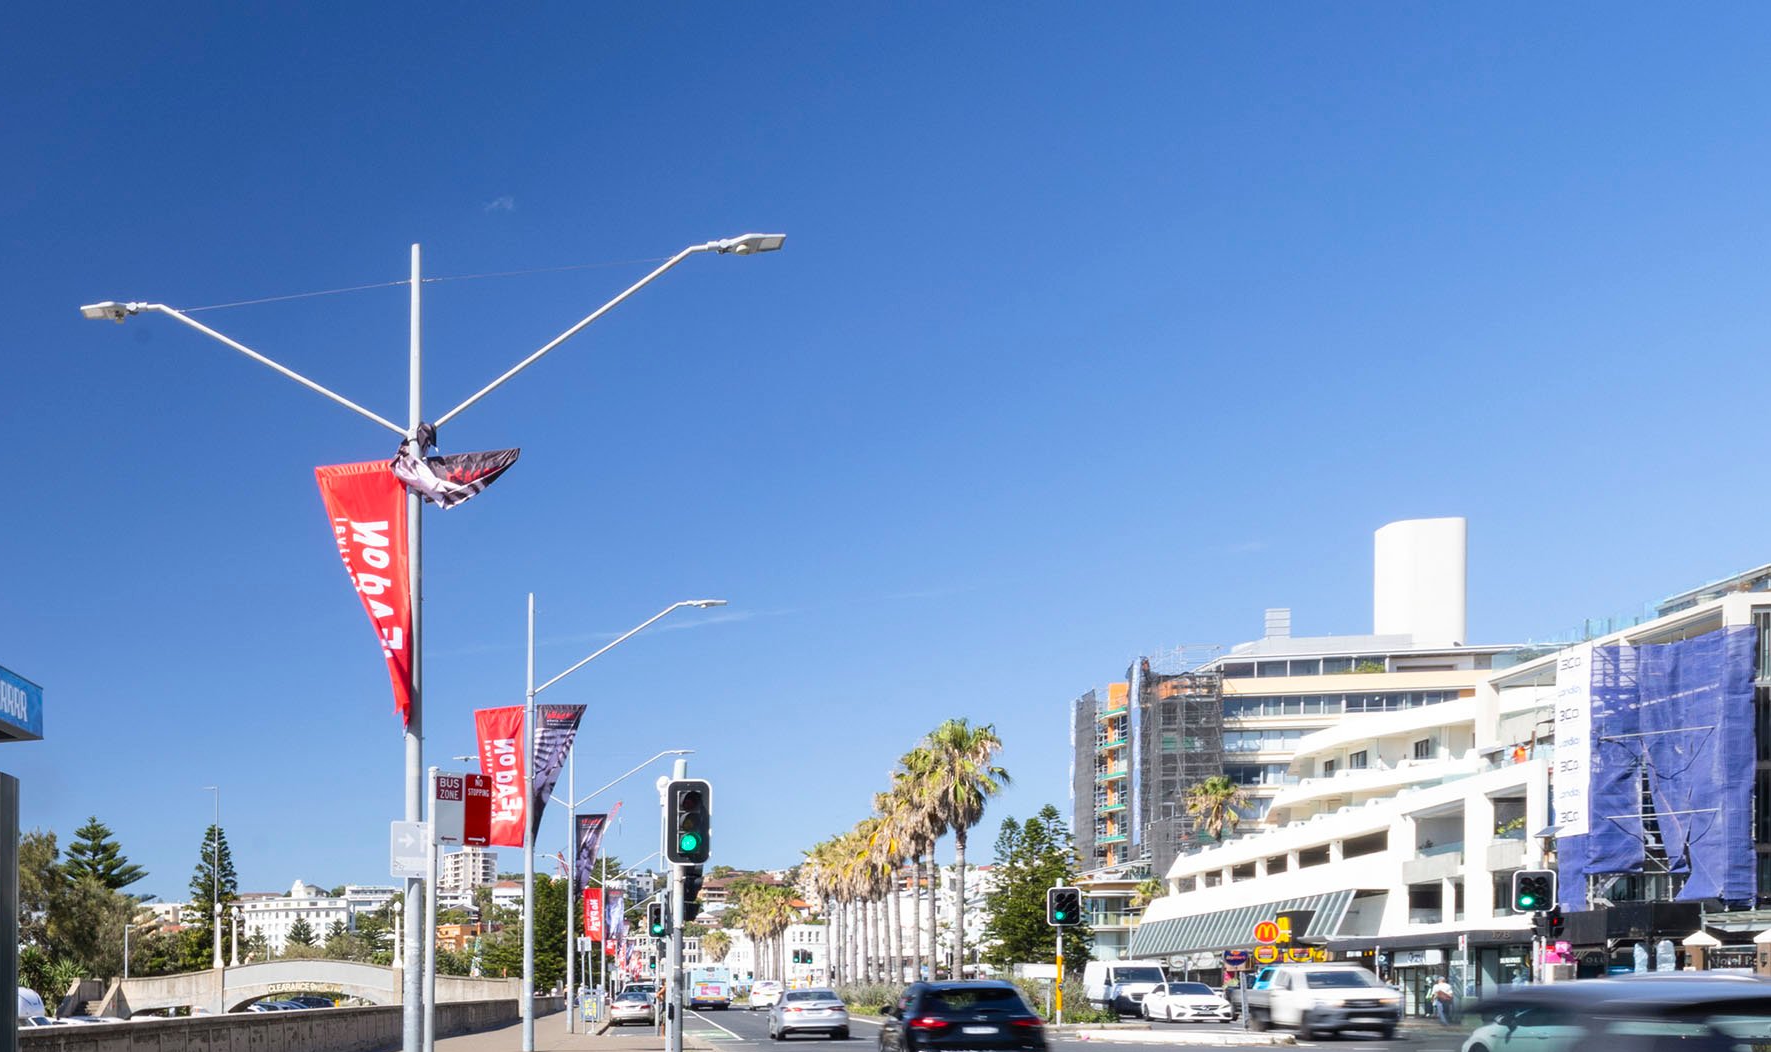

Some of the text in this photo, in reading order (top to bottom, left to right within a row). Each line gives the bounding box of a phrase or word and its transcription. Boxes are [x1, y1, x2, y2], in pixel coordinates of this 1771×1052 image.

[439, 777, 460, 788] BUS
[474, 779, 484, 787] NO
[439, 789, 460, 800] ZONE
[467, 788, 490, 797] STOPPING
[267, 983, 311, 993] CLEARANCE
